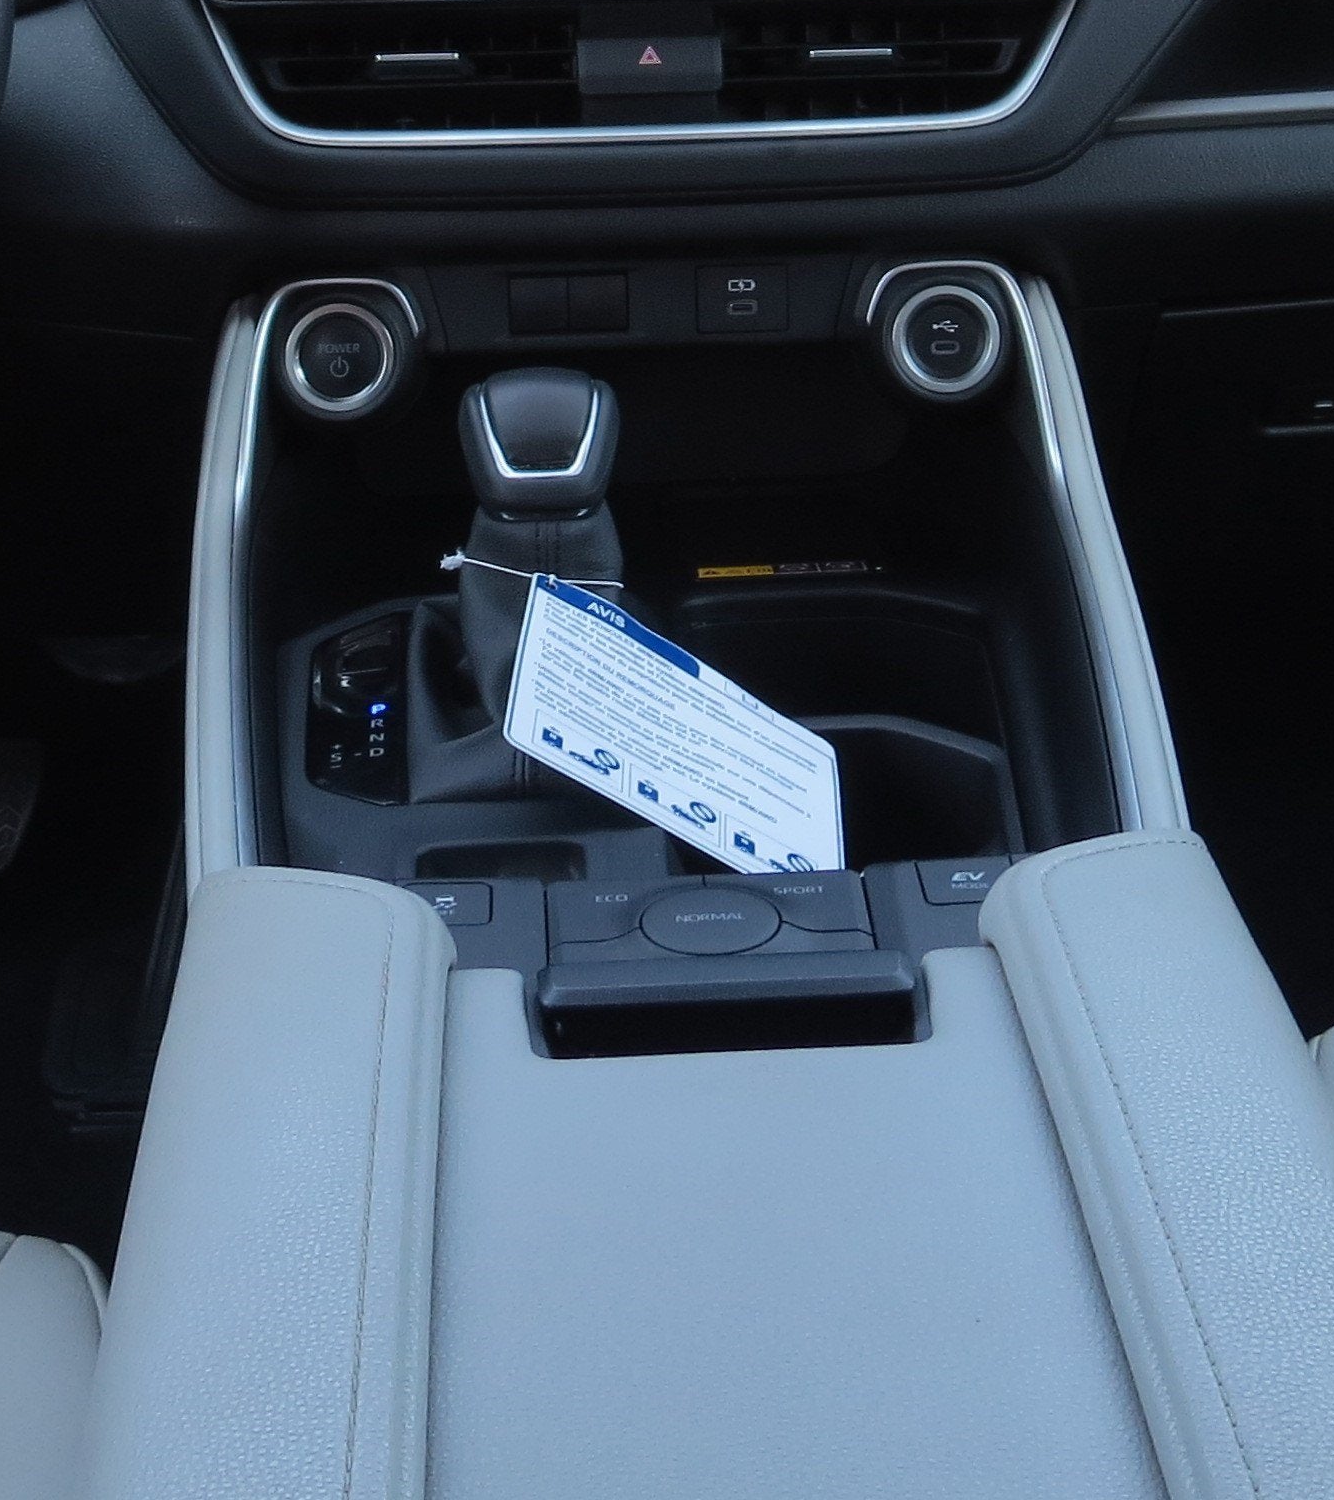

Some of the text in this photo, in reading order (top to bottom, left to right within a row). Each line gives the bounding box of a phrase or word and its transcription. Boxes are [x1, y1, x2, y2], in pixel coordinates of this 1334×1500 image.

[318, 342, 360, 354] POWER
[587, 601, 627, 628] AVIS
[371, 703, 386, 715] P
[370, 718, 384, 729] R
[369, 732, 385, 743] N
[369, 747, 385, 758] D
[951, 871, 986, 882] EV
[773, 884, 825, 895] SPORT
[595, 893, 629, 904] ECO
[675, 911, 746, 924] NORMAL
